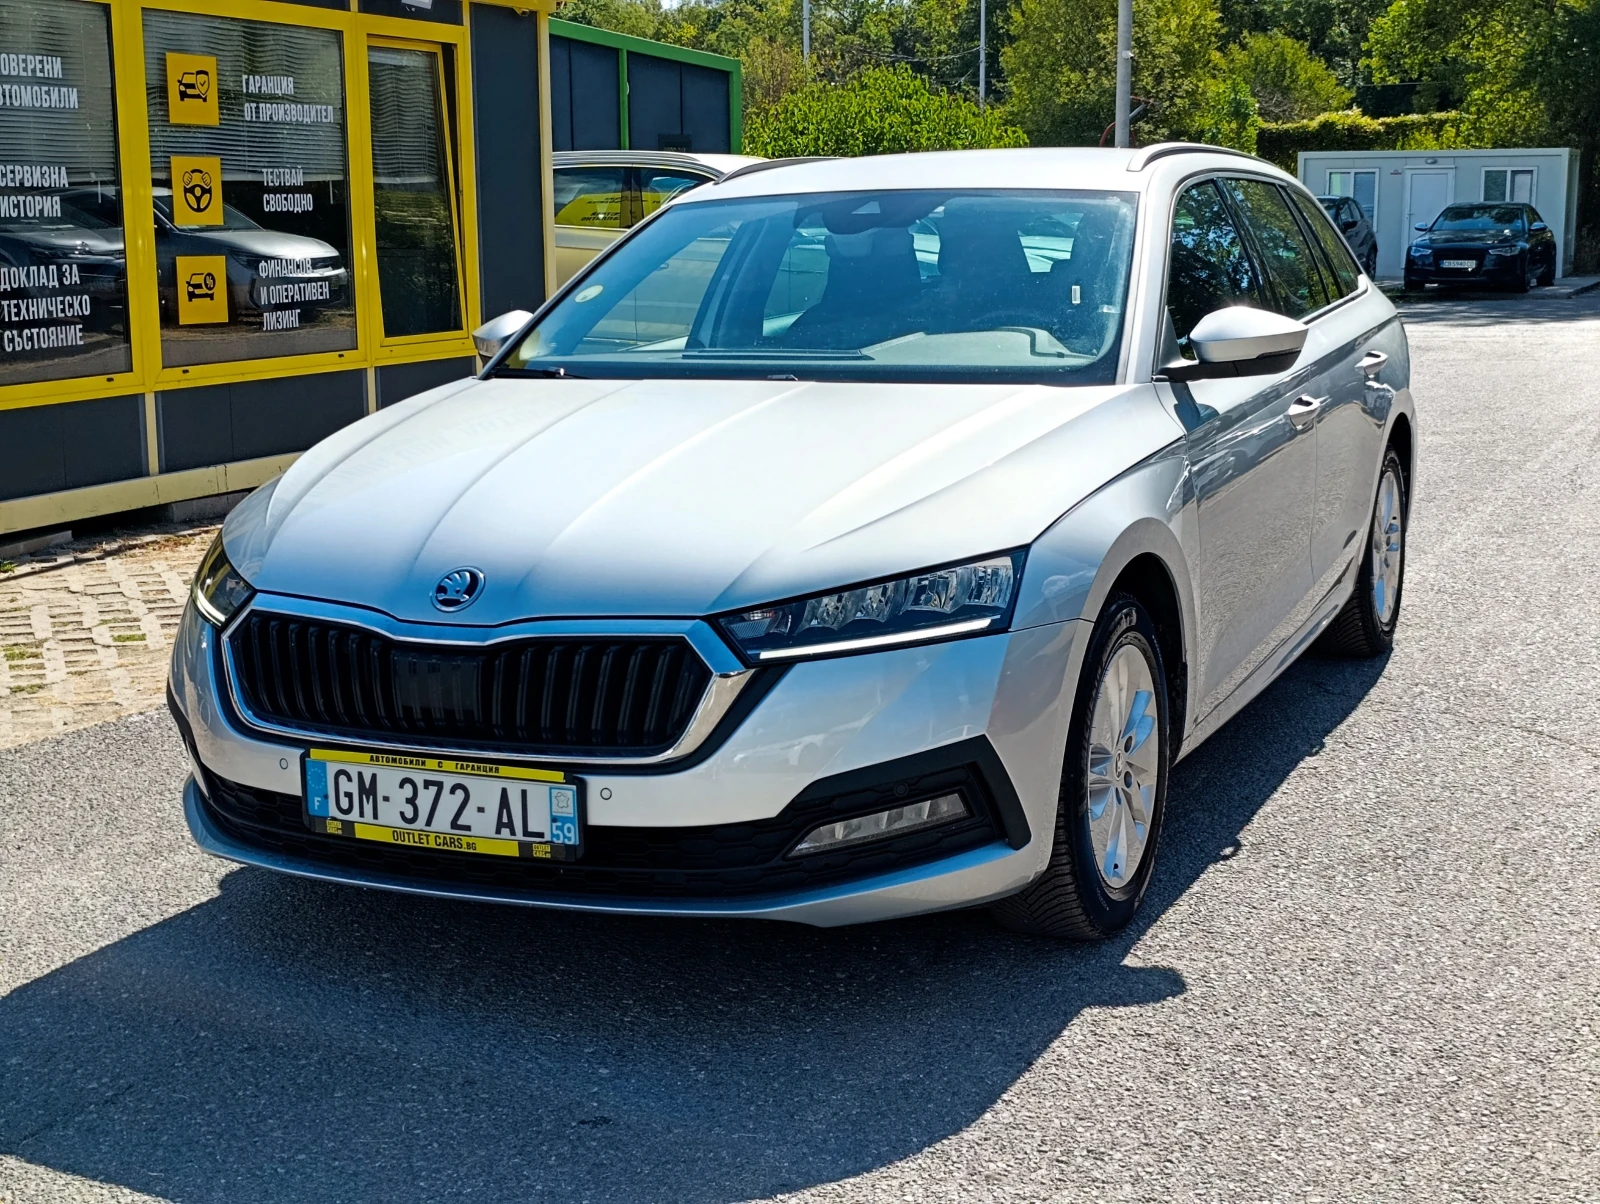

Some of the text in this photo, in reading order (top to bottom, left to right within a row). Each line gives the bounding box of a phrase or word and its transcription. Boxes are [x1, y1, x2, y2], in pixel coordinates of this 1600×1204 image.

[0, 53, 62, 78] ОВЕРЕНИ
[242, 75, 294, 96] ГАРАНЦИЯ
[244, 103, 333, 124] ОТ ПРОИЗВОДИТЕЛ
[0, 165, 69, 188] СЕРВИЗНА
[262, 165, 303, 186] ТЕСТВАЙ
[0, 195, 61, 218] ИСТОРИЯ
[263, 193, 313, 213] СВОБОДНО
[0, 264, 80, 291] ДОКЛАД ЗА
[258, 258, 312, 278] ФИНАНСОВ
[260, 281, 330, 305] И ОПЕРАТИВЕН
[1, 295, 91, 322] ТЕХНИЧЕСКО
[263, 309, 301, 331] ЛИЗИНГ
[3, 324, 84, 352] СЪСТОЯНИЕ
[369, 755, 426, 767] АВТОМОБИЛИ
[455, 762, 500, 774] ГАРАНЦИЯ
[314, 797, 321, 810] F
[333, 768, 545, 839] GM-372-AL
[392, 830, 430, 846] OUTLET
[552, 822, 575, 845] 59
